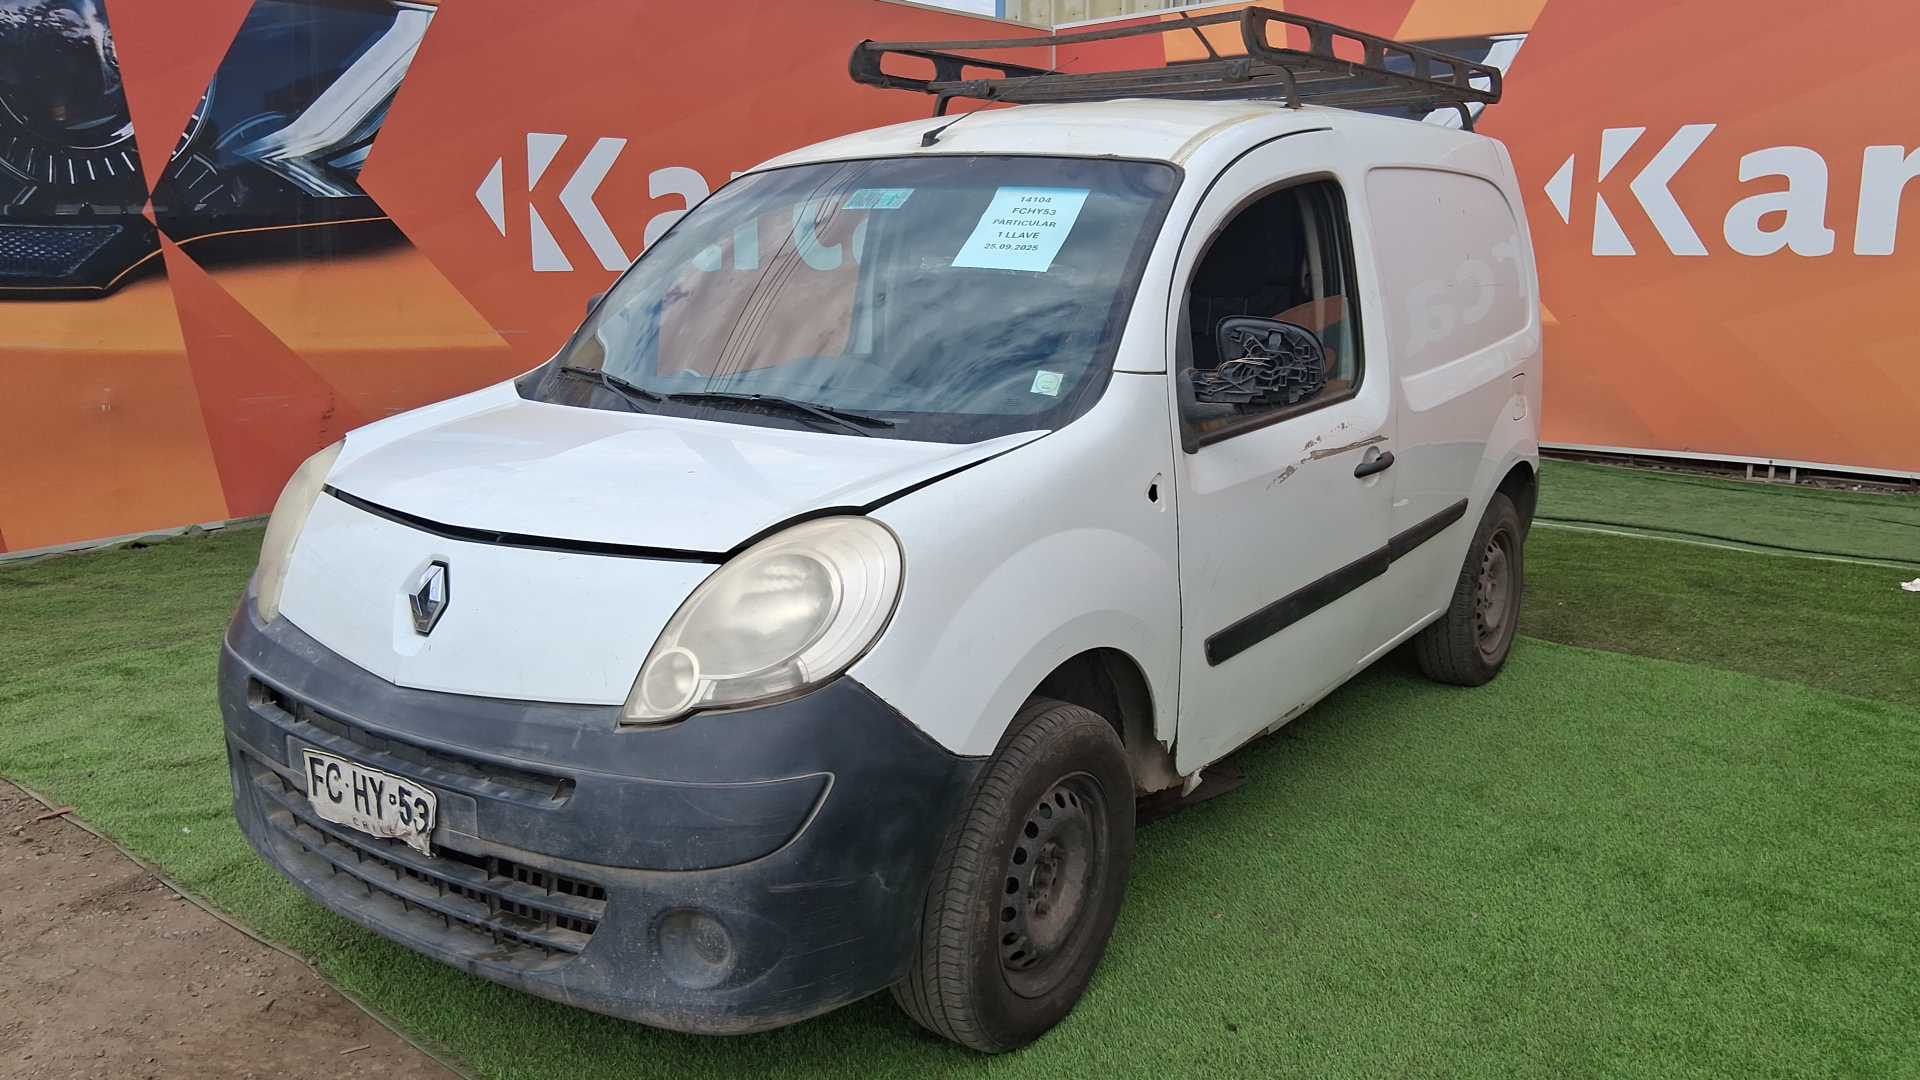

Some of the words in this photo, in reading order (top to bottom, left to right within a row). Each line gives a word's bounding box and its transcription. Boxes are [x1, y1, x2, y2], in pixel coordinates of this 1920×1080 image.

[1012, 207, 1057, 216] FCHY53
[992, 218, 1057, 228] PARTICULAR
[1004, 231, 1041, 239] LLAVE
[983, 242, 1039, 251] 25.09.2025
